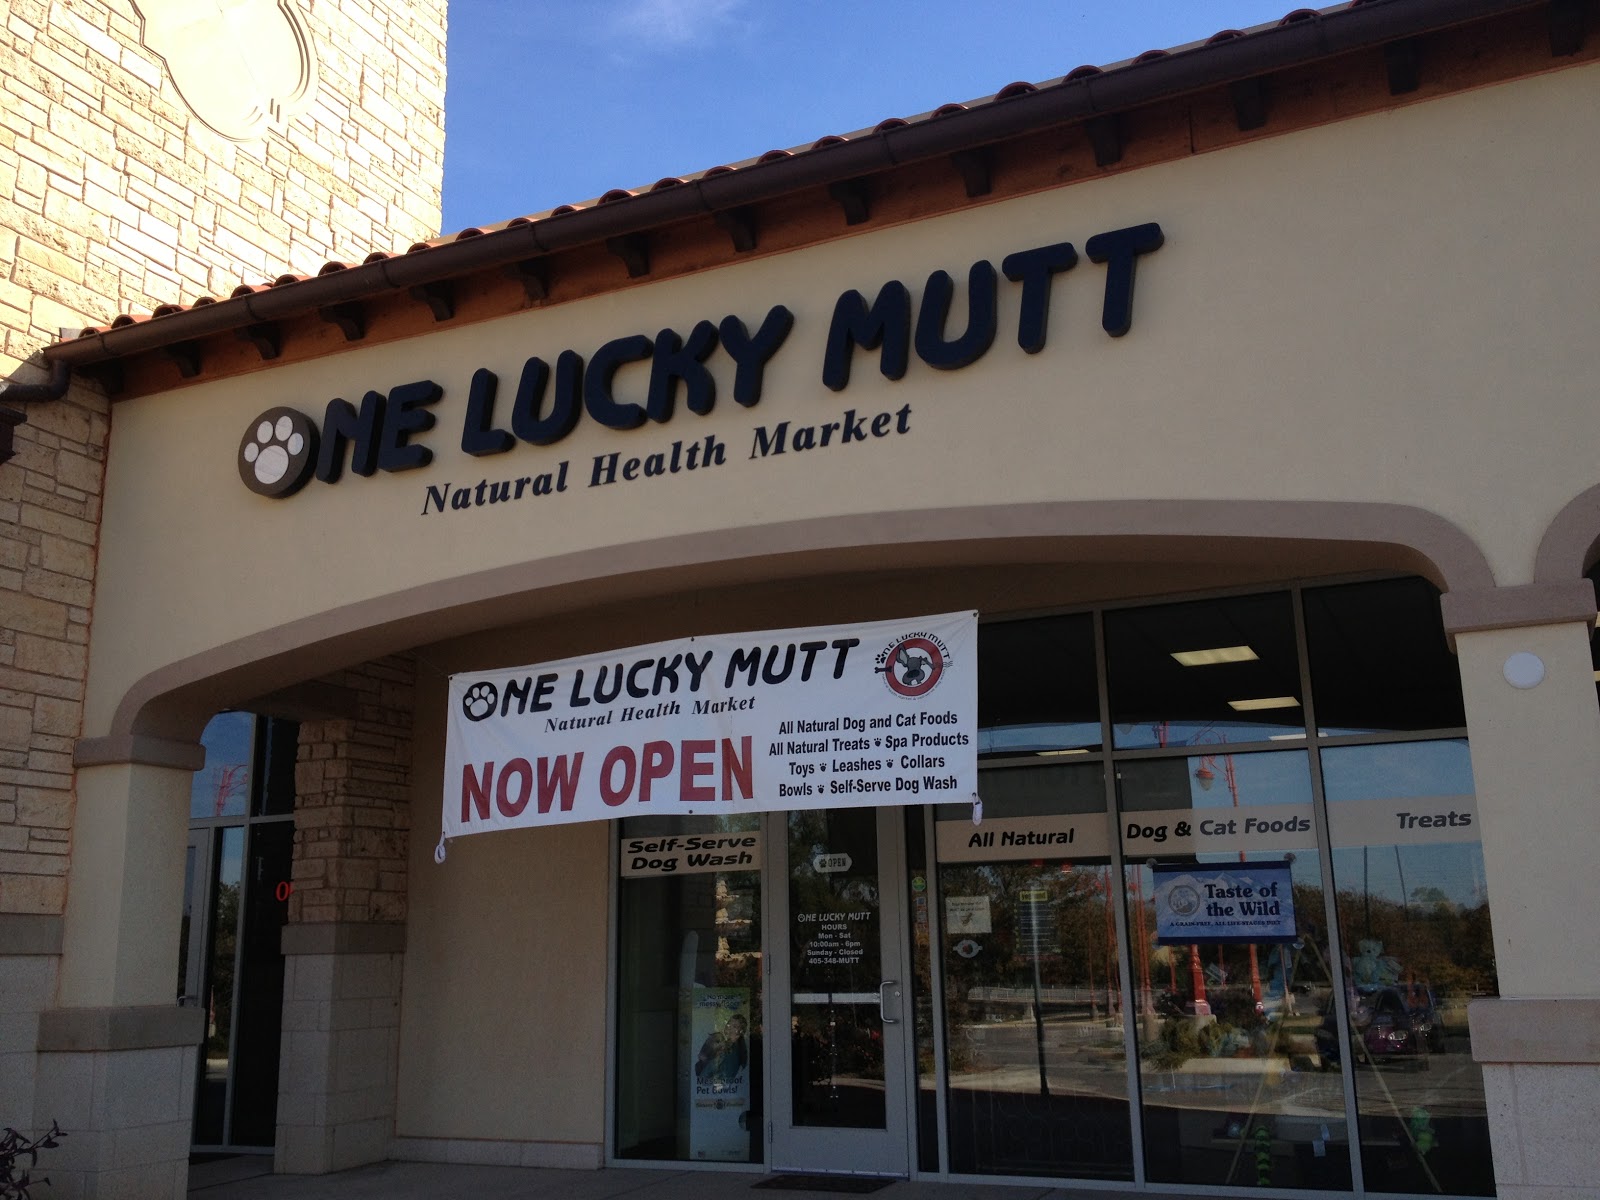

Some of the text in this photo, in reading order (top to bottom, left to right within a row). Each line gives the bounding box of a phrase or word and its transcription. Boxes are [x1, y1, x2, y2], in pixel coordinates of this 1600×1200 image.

[461, 304, 794, 457] LUCKY
[822, 222, 1165, 391] MUTT
[421, 403, 912, 515] Natural Health Market
[928, 633, 950, 659] MUTT
[569, 650, 713, 707] LUCKY
[725, 638, 860, 688] MUTT
[544, 696, 755, 733] Natural Health Market
[779, 711, 958, 735] All Natural Dog and Cat Foods
[769, 732, 969, 756] All Natural Treats Spa Products
[789, 755, 945, 778] Toys Leashes Collars
[461, 736, 754, 823] NOW OPEN
[779, 776, 958, 797] Bowls Self-Serve Dog Wash
[1127, 816, 1310, 842] Dog & Cat Foods
[1396, 811, 1472, 829] Treats
[627, 835, 756, 854] Self-Serve
[968, 827, 1075, 848] All Natural
[631, 851, 753, 872] Dog Wash
[828, 858, 847, 868] OPEN
[1204, 882, 1278, 898] Taste of
[819, 913, 846, 922] LUCKY
[848, 912, 871, 920] MUTT
[1206, 900, 1280, 916] the Wild
[807, 949, 833, 957] Sunday
